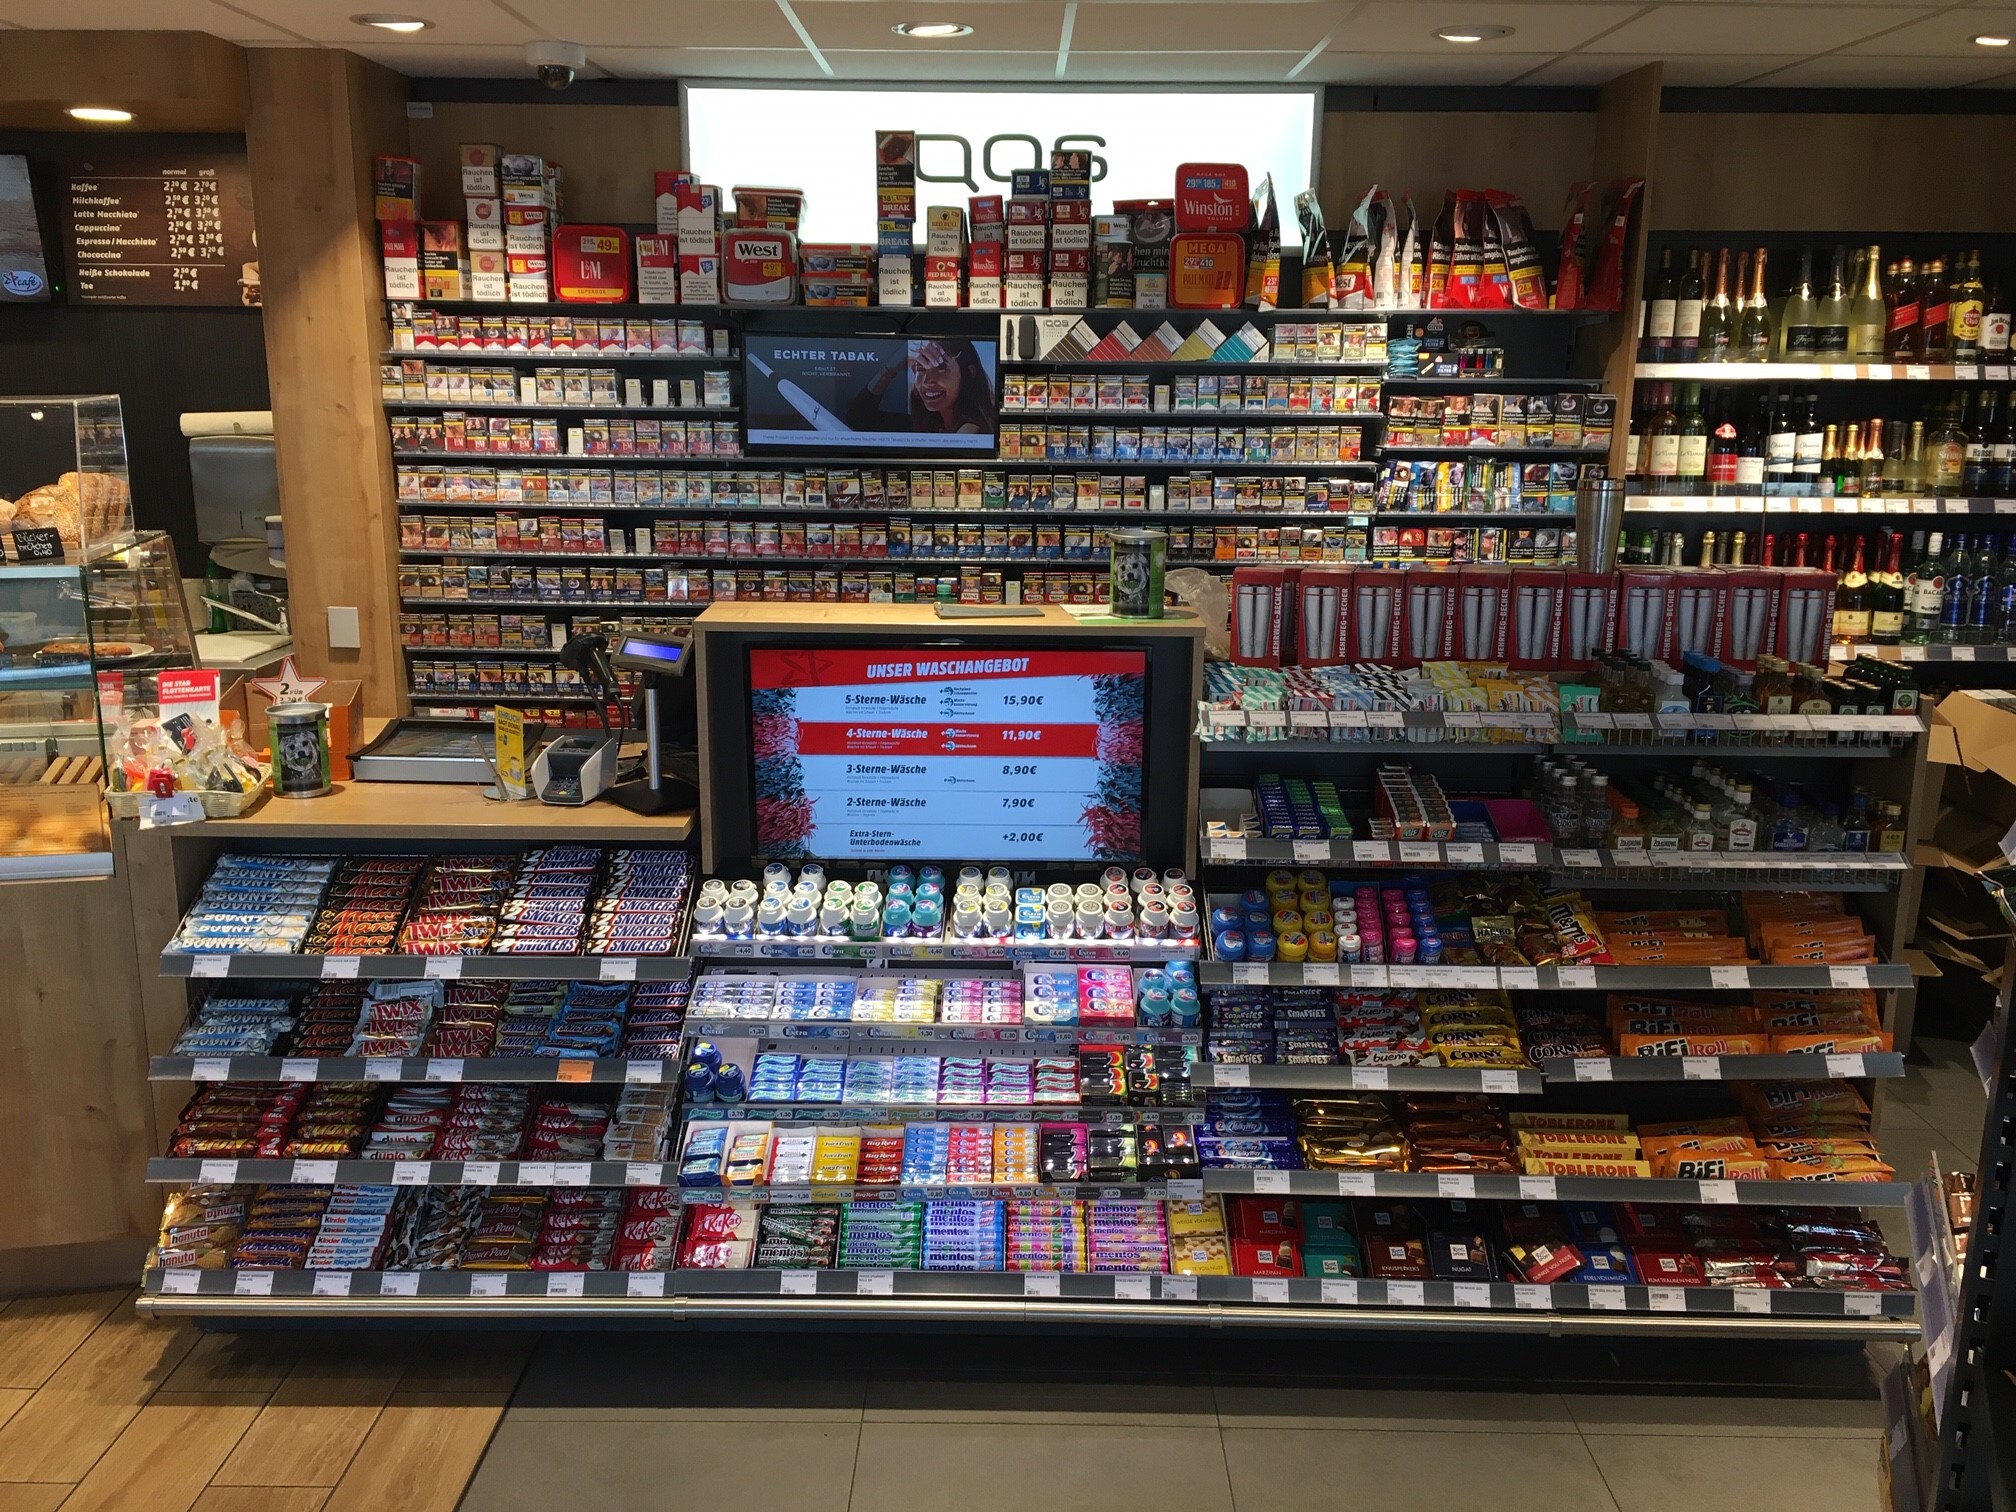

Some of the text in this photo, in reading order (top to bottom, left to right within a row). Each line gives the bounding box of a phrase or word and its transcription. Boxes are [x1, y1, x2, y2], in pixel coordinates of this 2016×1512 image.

[915, 133, 1108, 193] QOS
[199, 169, 215, 177] groß
[1184, 199, 1233, 216] Winston
[680, 228, 712, 236] Rauchen
[690, 236, 714, 244] tödlich
[880, 238, 910, 246] BREAK
[738, 243, 778, 257] West
[1188, 243, 1225, 254] MEGA
[384, 266, 417, 274] Rauchen
[879, 267, 910, 275] Rauchen
[973, 262, 995, 270] Winston
[79, 269, 103, 277] Heiße
[104, 268, 150, 277] Schokolade
[472, 275, 504, 283] Rauchen
[1052, 280, 1087, 288] Rauchen
[80, 282, 94, 290] Tee
[389, 281, 415, 289] tödlich
[512, 283, 545, 291] Rauchen
[1007, 282, 1042, 290] Rauchen
[476, 289, 501, 297] tödlich
[523, 290, 548, 299] tödlich
[882, 287, 907, 296] tödlich
[973, 296, 997, 304] tödlich
[1011, 299, 1038, 307] tödlich
[1055, 297, 1083, 306] tödlich
[1042, 319, 1069, 328] IQOS
[774, 350, 879, 362] ECHTER TABAK.
[1972, 449, 1992, 457] Hanse
[1273, 586, 1283, 657] MEHRWEG-BECHER
[1339, 588, 1348, 657] MEHRWEG-BECHER
[1392, 588, 1402, 657] MEHRWEG-BECHER
[1444, 588, 1455, 657] MEHRWEG-BECHER
[1497, 588, 1508, 658] MEHRWEG-BECHER
[1551, 588, 1564, 658] MEHRWEG-BECHER
[1663, 588, 1675, 659] MEHRWEG-BECHER
[1714, 590, 1726, 660] MEHRWEG-BECHER
[866, 658, 1030, 679] UNSER WASCHANGEBOT
[162, 686, 211, 694] FLOTTENKARTE
[280, 683, 289, 695] 2
[844, 693, 1044, 707] 5-Sterne-Wäsche 15,90€
[846, 728, 1041, 742] 4-Sterne-Wäsche 11,90€
[846, 764, 1038, 776] 3-Sterne-Wäsche 8,90€
[846, 796, 1036, 810] 2-Sterne-Wäsche 7,90€
[850, 829, 1044, 844] Extra-Stern- +2,00€
[850, 837, 922, 847] Unterbodenwäsche
[629, 851, 687, 863] SNICKERS
[434, 875, 493, 892] TWIX
[534, 873, 593, 885] SNICKERS
[333, 910, 402, 922] Mars
[327, 921, 396, 934] Mars
[1477, 928, 1512, 938] HARIBO
[182, 938, 248, 949] BOUNTY
[609, 940, 671, 952] SNICKERS
[638, 982, 690, 995] SNICKERS
[1287, 1008, 1326, 1018] SMARTIES
[437, 1028, 495, 1044] TWIX
[1360, 1027, 1394, 1039] bueno
[1432, 1030, 1485, 1045] CORNY
[1692, 1040, 1728, 1056] Roll
[1222, 1054, 1264, 1064] SMARTIES
[1373, 1052, 1407, 1063] bueno
[1449, 1049, 1503, 1062] CORNY
[395, 1114, 430, 1125] duplo
[867, 1140, 881, 1148] Big
[1537, 1133, 1627, 1145] TOBLERONE
[1545, 1162, 1637, 1177] TOBLERONE
[1728, 1166, 1765, 1180] Roll
[1094, 1205, 1137, 1213] mentos
[347, 1216, 371, 1225] Riegel
[706, 1214, 742, 1232] KitKat
[171, 1228, 208, 1244] hanuta
[625, 1221, 660, 1241] KitKat
[849, 1230, 893, 1240] mentos
[463, 1248, 510, 1261] PRINCE POLO
[761, 1248, 803, 1257] mentos
[929, 1252, 974, 1261] mentos
[1013, 1252, 1049, 1261] mentos
[159, 1251, 195, 1267] hanuta
[1094, 1264, 1139, 1273] mentos
